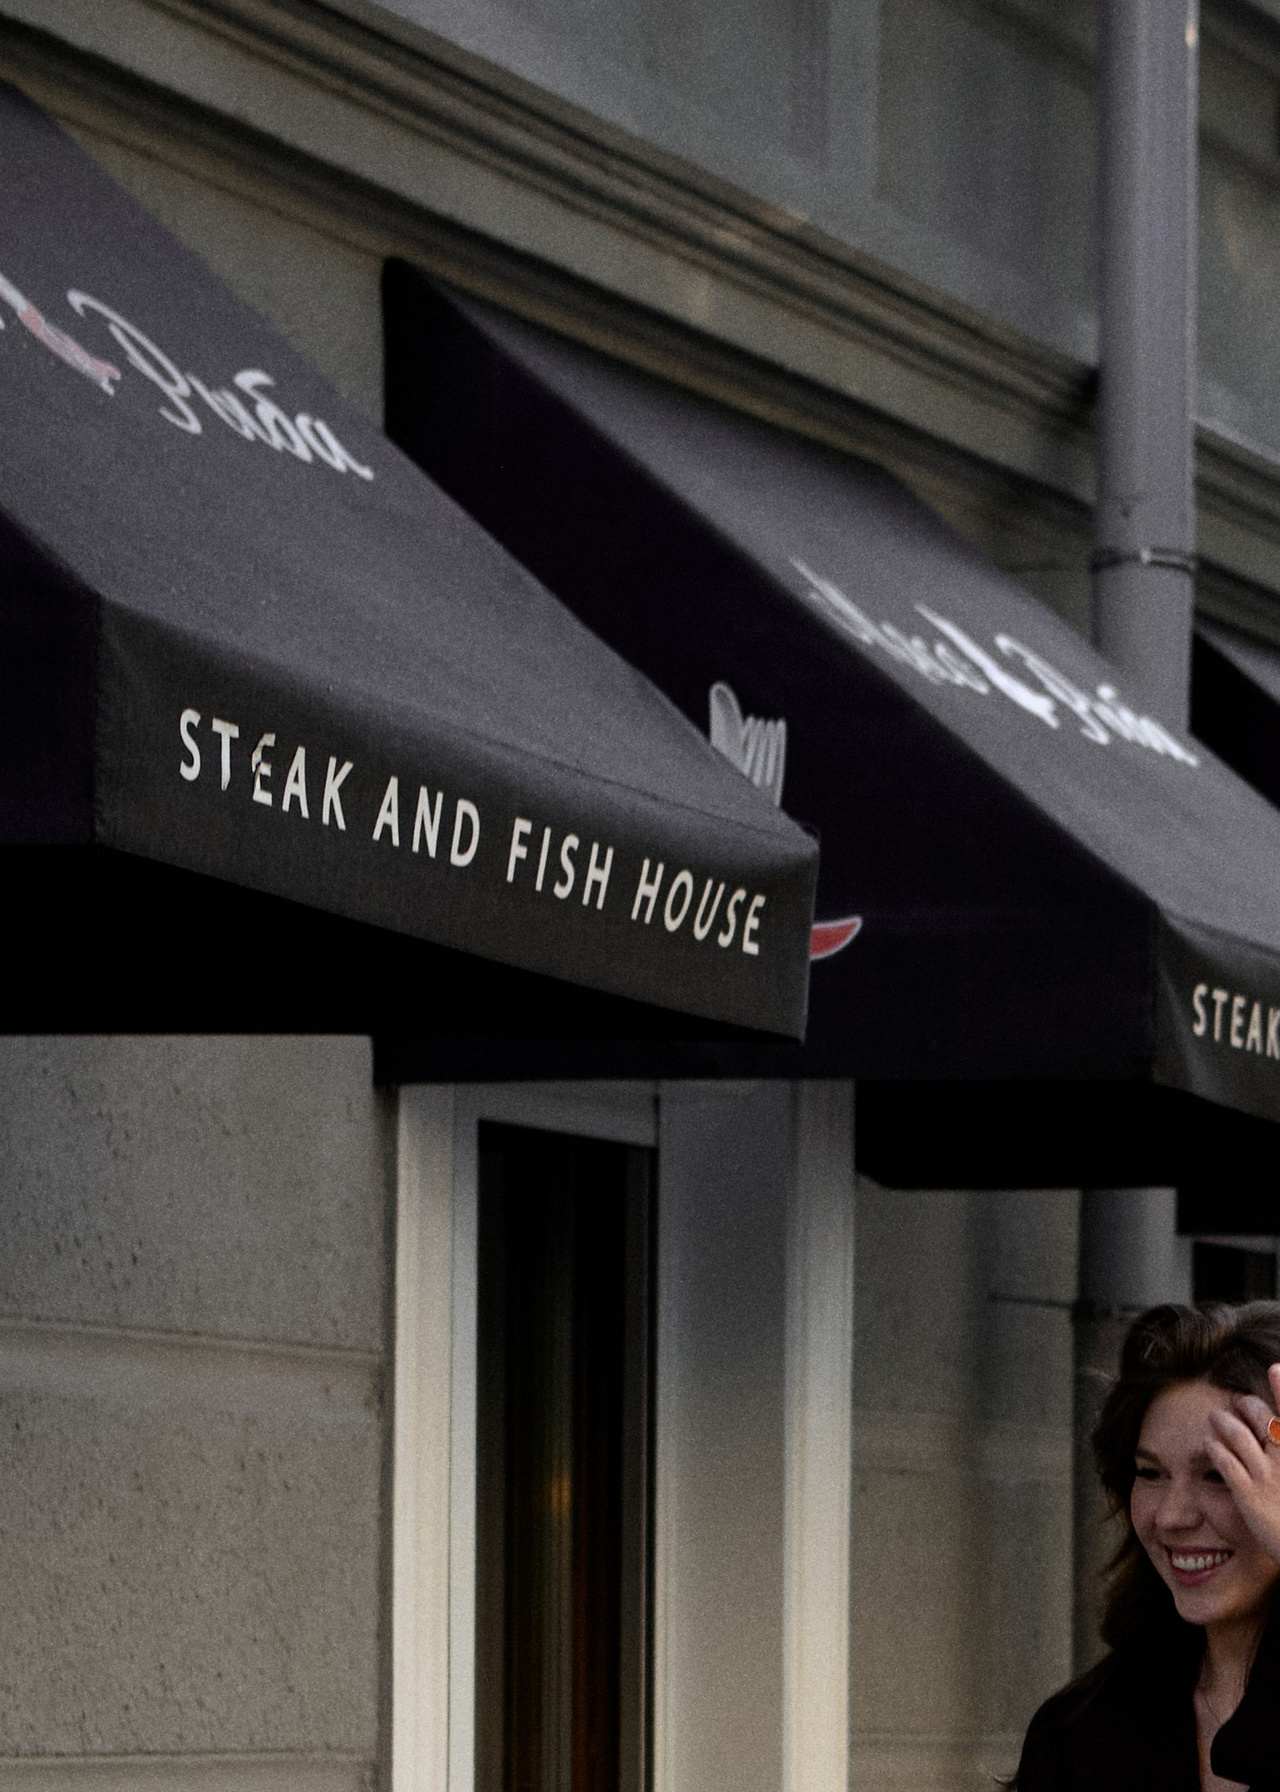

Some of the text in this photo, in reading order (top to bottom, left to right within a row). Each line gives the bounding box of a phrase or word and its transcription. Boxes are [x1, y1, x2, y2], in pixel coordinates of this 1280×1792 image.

[179, 708, 766, 955] STEAK AND FISH HOUSE
